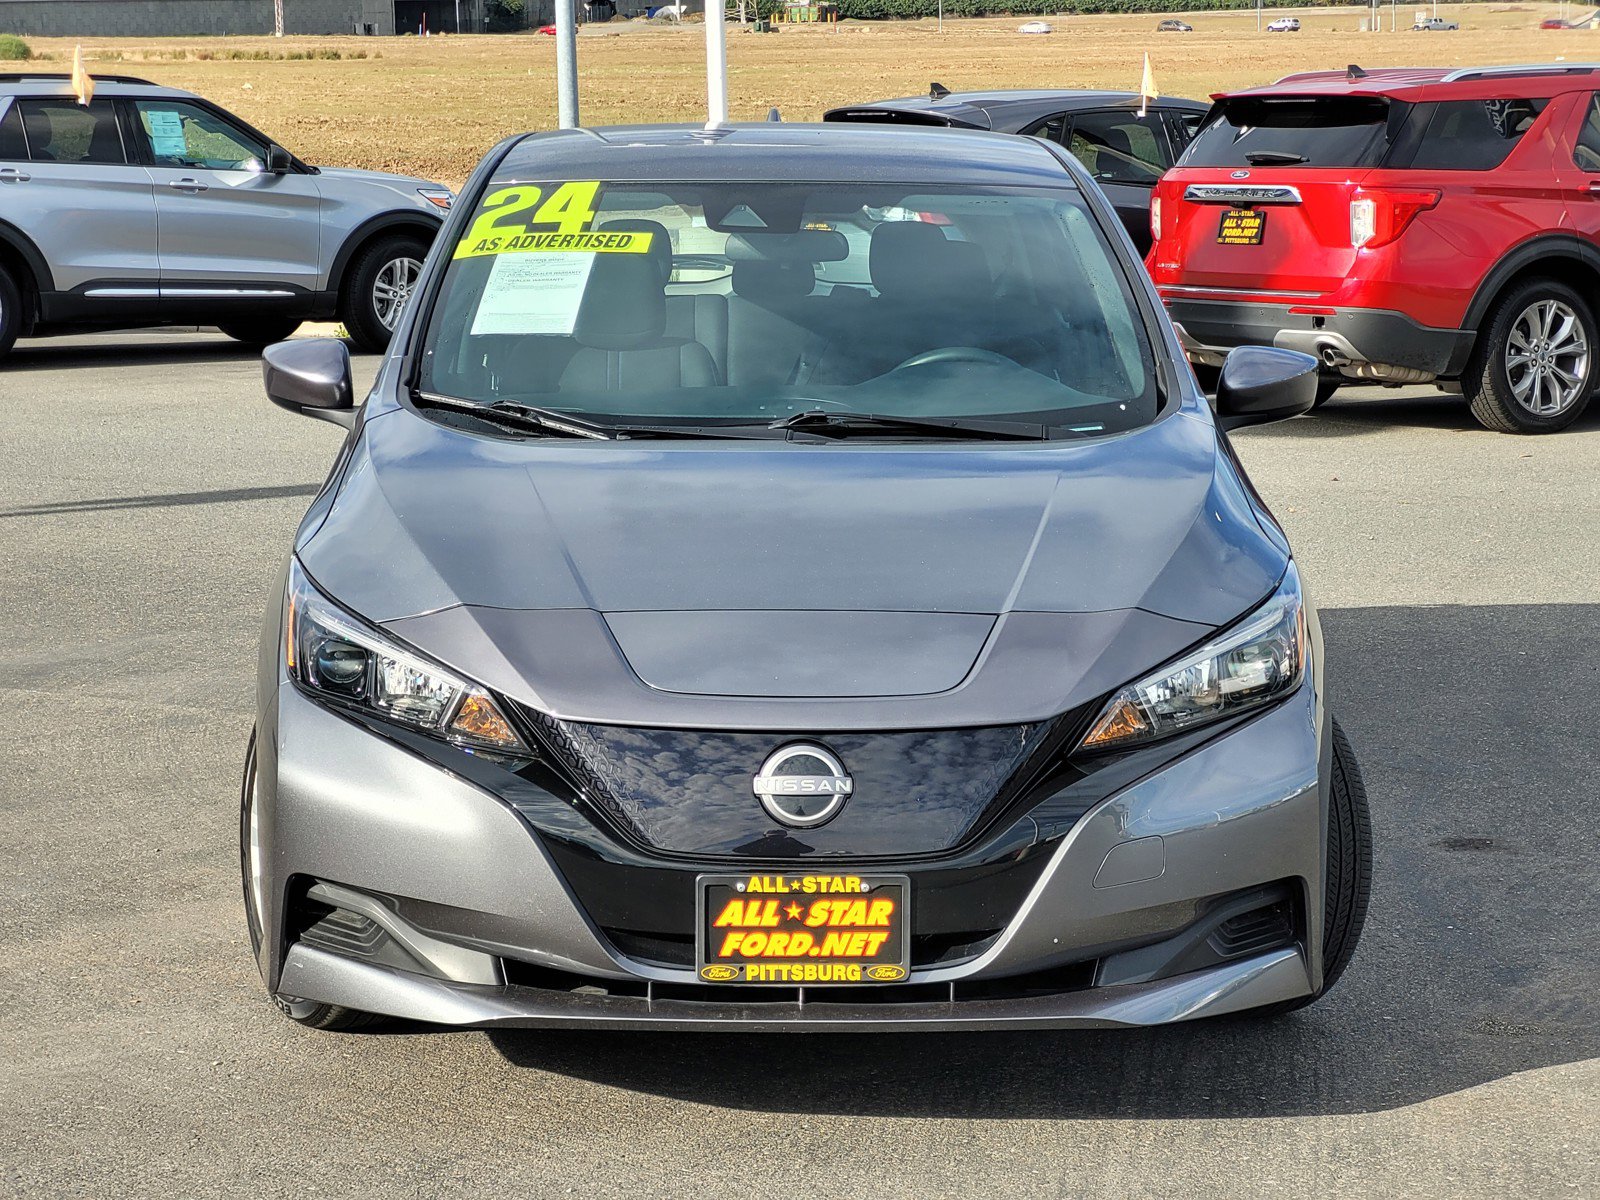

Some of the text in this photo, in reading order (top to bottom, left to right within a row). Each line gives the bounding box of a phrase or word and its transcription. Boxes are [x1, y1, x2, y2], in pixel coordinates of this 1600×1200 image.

[1197, 188, 1276, 198] EXPLORER
[468, 181, 600, 240] 24
[1223, 218, 1261, 227] ALL STAR
[472, 234, 634, 253] AS ADVERTISED
[756, 779, 851, 792] NISSAN
[746, 876, 861, 893] ALL STAR
[713, 899, 895, 928] ALL STAR
[718, 931, 891, 958] FORD.NET
[708, 964, 898, 981] Ford PITTSBURG Ford
